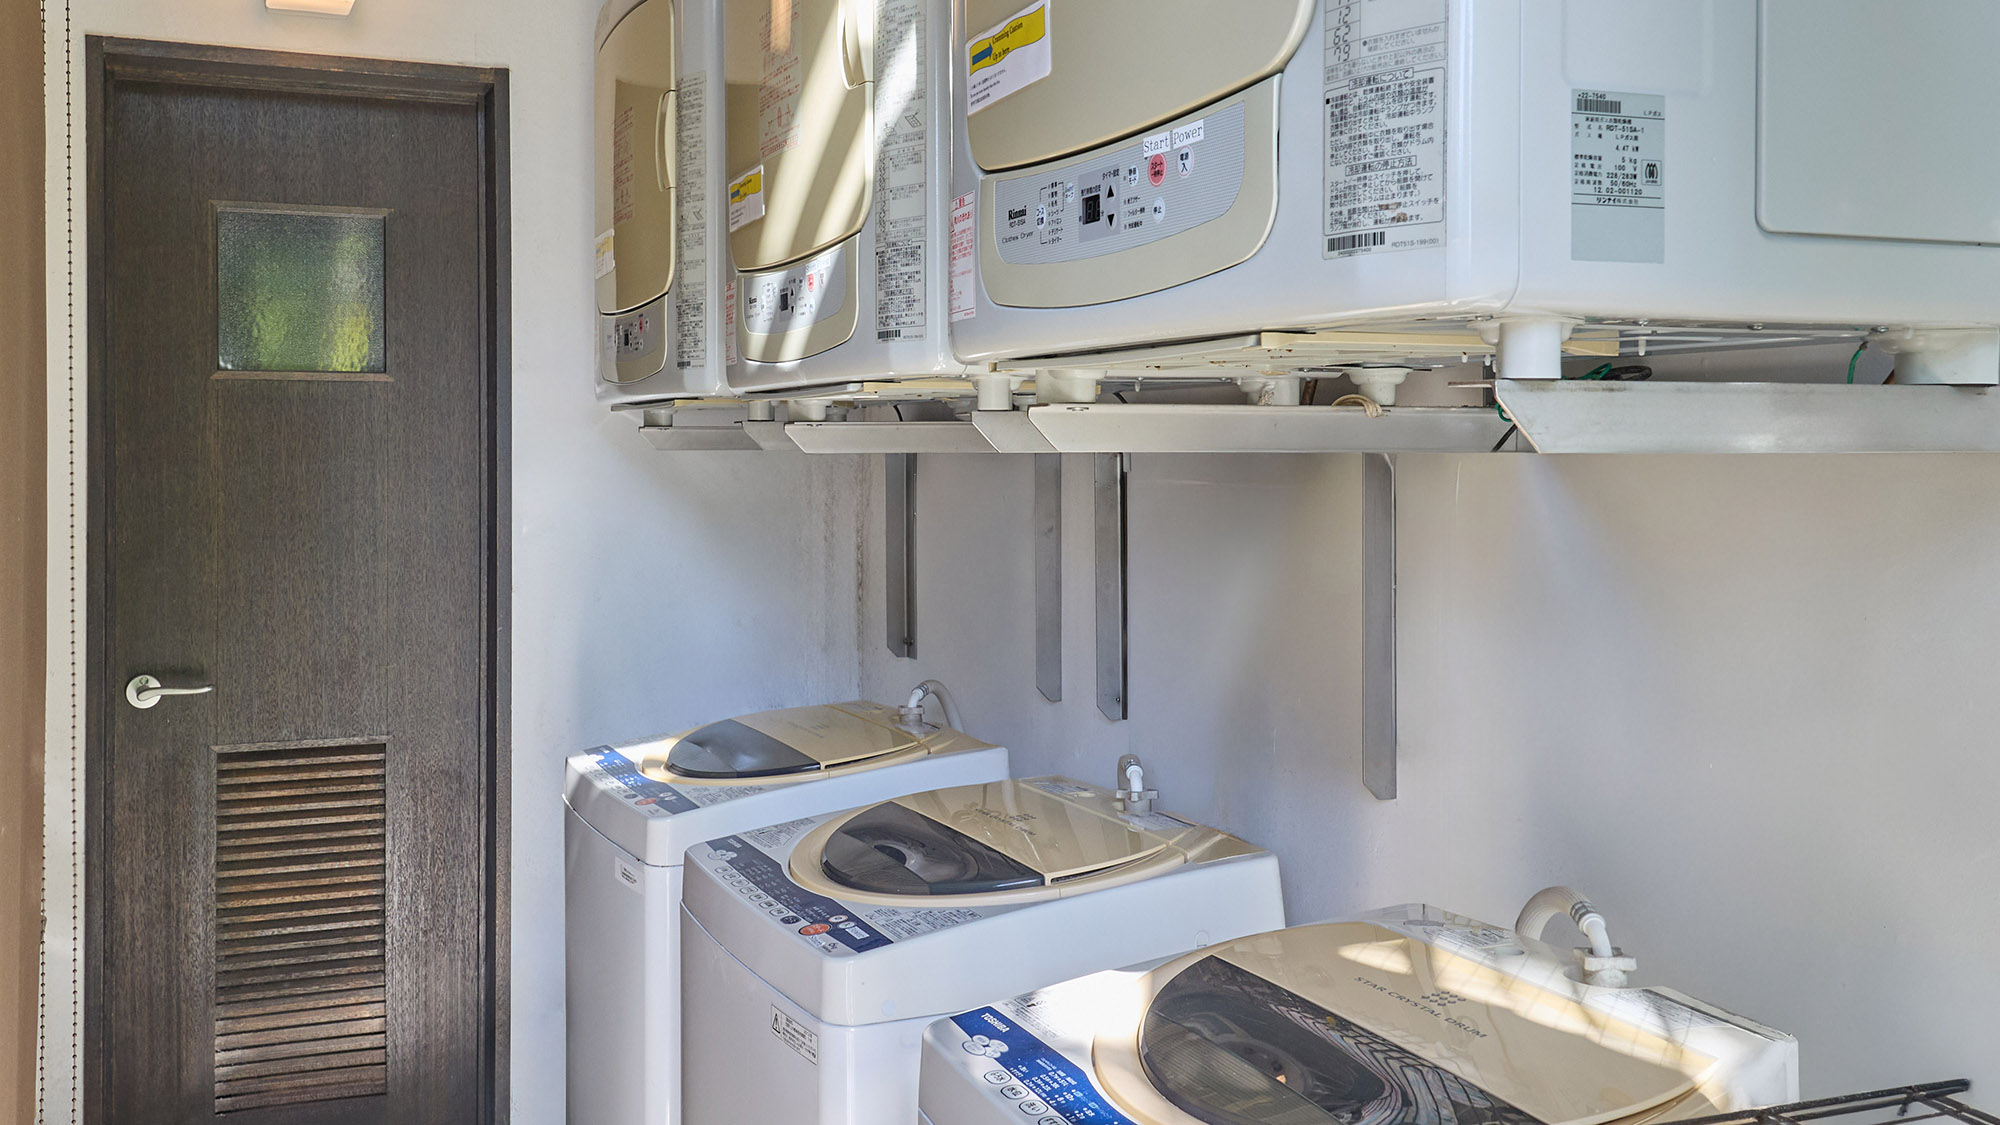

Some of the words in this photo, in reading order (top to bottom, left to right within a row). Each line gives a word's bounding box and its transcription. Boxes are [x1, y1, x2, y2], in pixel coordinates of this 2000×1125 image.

[1338, 6, 1351, 24] 12
[1333, 24, 1351, 46] 62
[1606, 124, 1644, 133] RDT-51SA-1
[1143, 136, 1170, 153] Start
[1173, 126, 1203, 145] Power
[1629, 157, 1637, 165] kg
[1181, 163, 1188, 173] 入
[1615, 164, 1626, 172] 100
[1610, 180, 1637, 188] 50/60Hz
[1008, 205, 1027, 220] Rinnai
[1020, 231, 1034, 239] Dryer
[1354, 976, 1387, 992] STAR
[1388, 991, 1442, 1018] CRYSTAL
[1444, 1017, 1488, 1038] DRUM
[981, 1012, 1010, 1033] TOSHIBA
